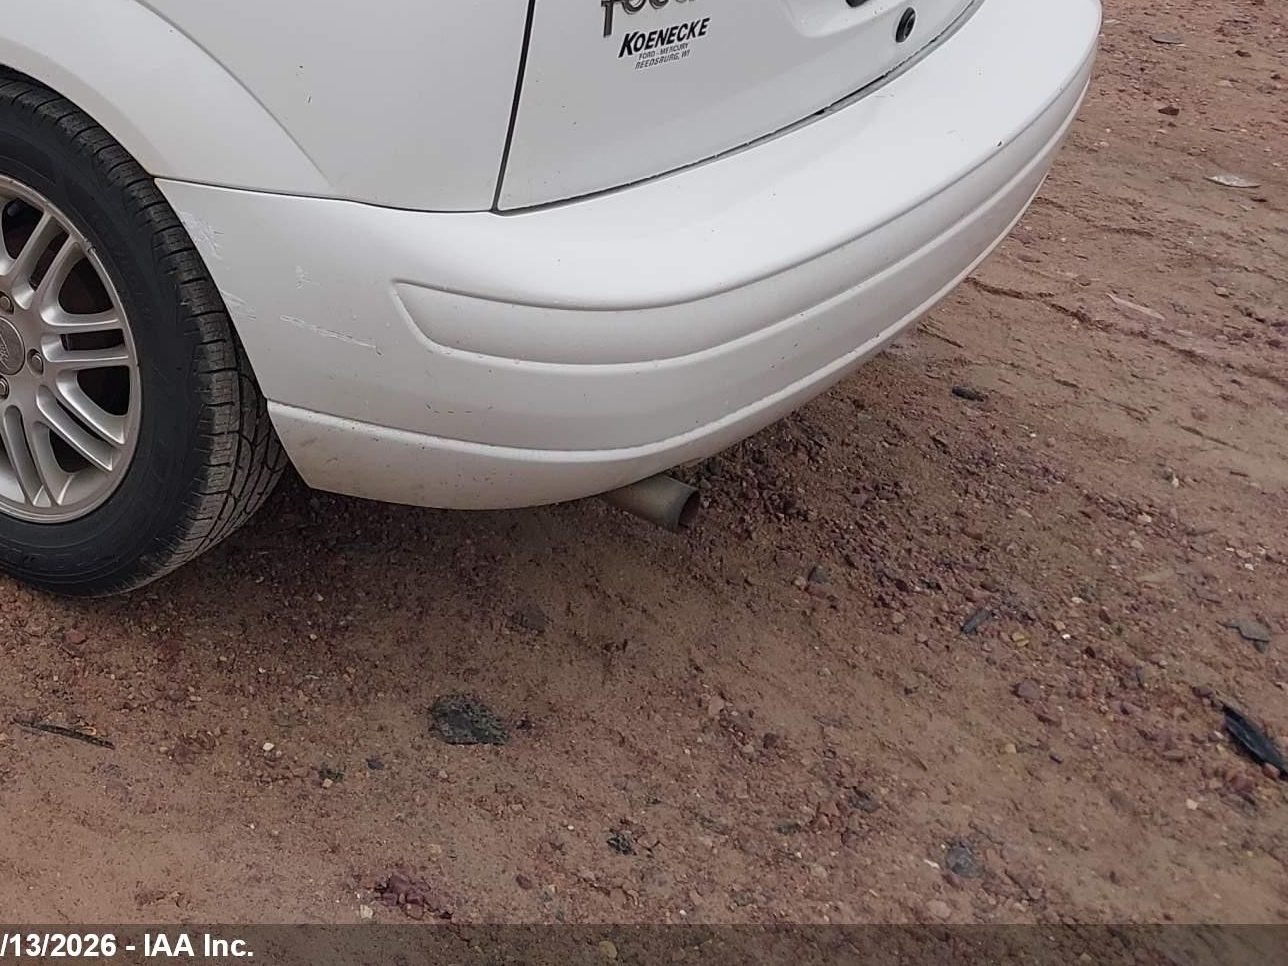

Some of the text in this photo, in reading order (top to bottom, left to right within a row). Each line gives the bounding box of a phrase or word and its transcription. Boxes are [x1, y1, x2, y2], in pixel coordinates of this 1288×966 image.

[618, 18, 710, 58] KOENECKE
[639, 50, 656, 61] FORD
[660, 43, 689, 55] MERCURY
